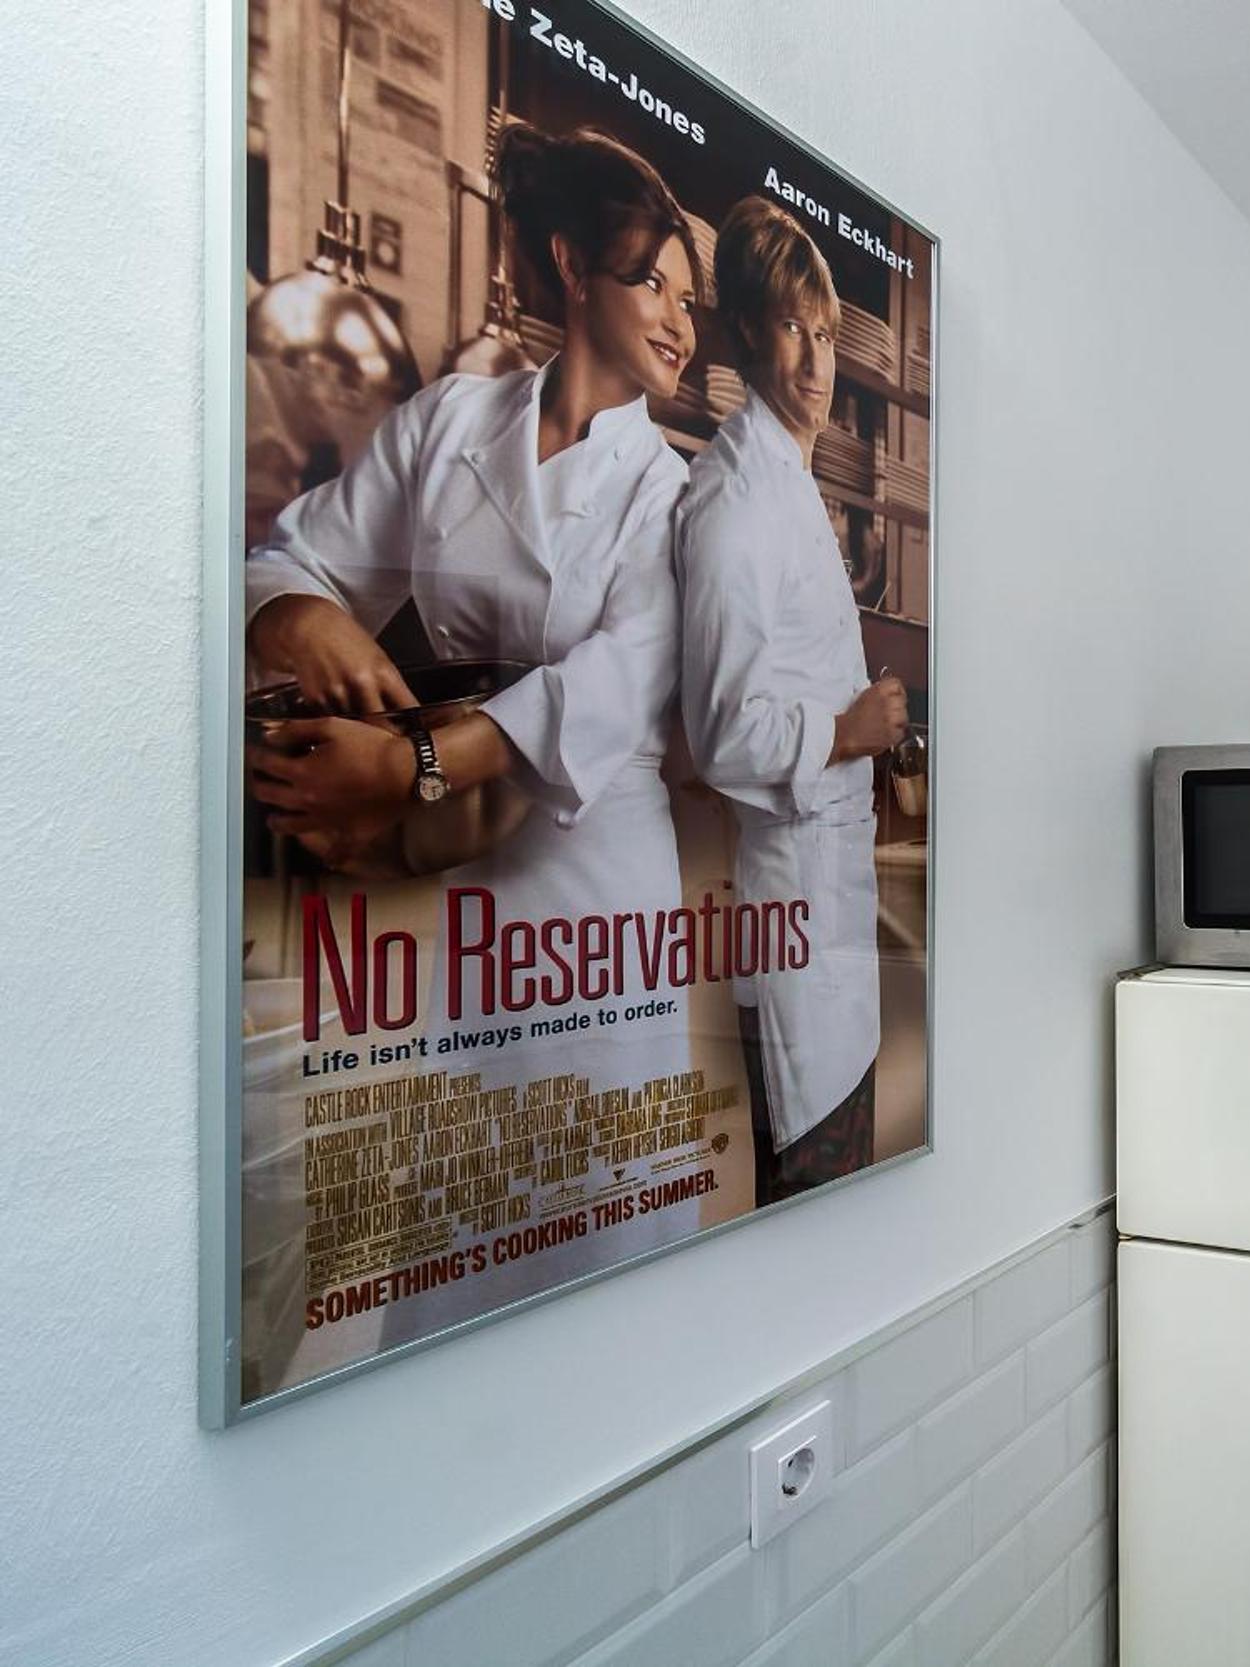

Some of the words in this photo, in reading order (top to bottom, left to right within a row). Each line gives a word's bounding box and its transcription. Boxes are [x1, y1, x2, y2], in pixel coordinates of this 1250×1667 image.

[529, 8, 706, 146] Zeta-Jones
[764, 167, 831, 226] Aaron
[837, 216, 916, 280] Eckhart
[302, 891, 418, 1042] No
[447, 886, 811, 1021] Reservations
[302, 1050, 360, 1077] Life
[436, 1026, 523, 1055] always
[530, 1016, 591, 1038] made
[597, 1009, 618, 1026] to
[624, 999, 679, 1021] order.
[306, 1091, 343, 1127] CASTLE
[373, 1072, 446, 1113] ENTERTAINMENT
[305, 1244, 486, 1331] SOMETHING'S
[492, 1212, 588, 1265] COOKING
[592, 1192, 634, 1230] THIS
[637, 1169, 720, 1214] SUMMER.
